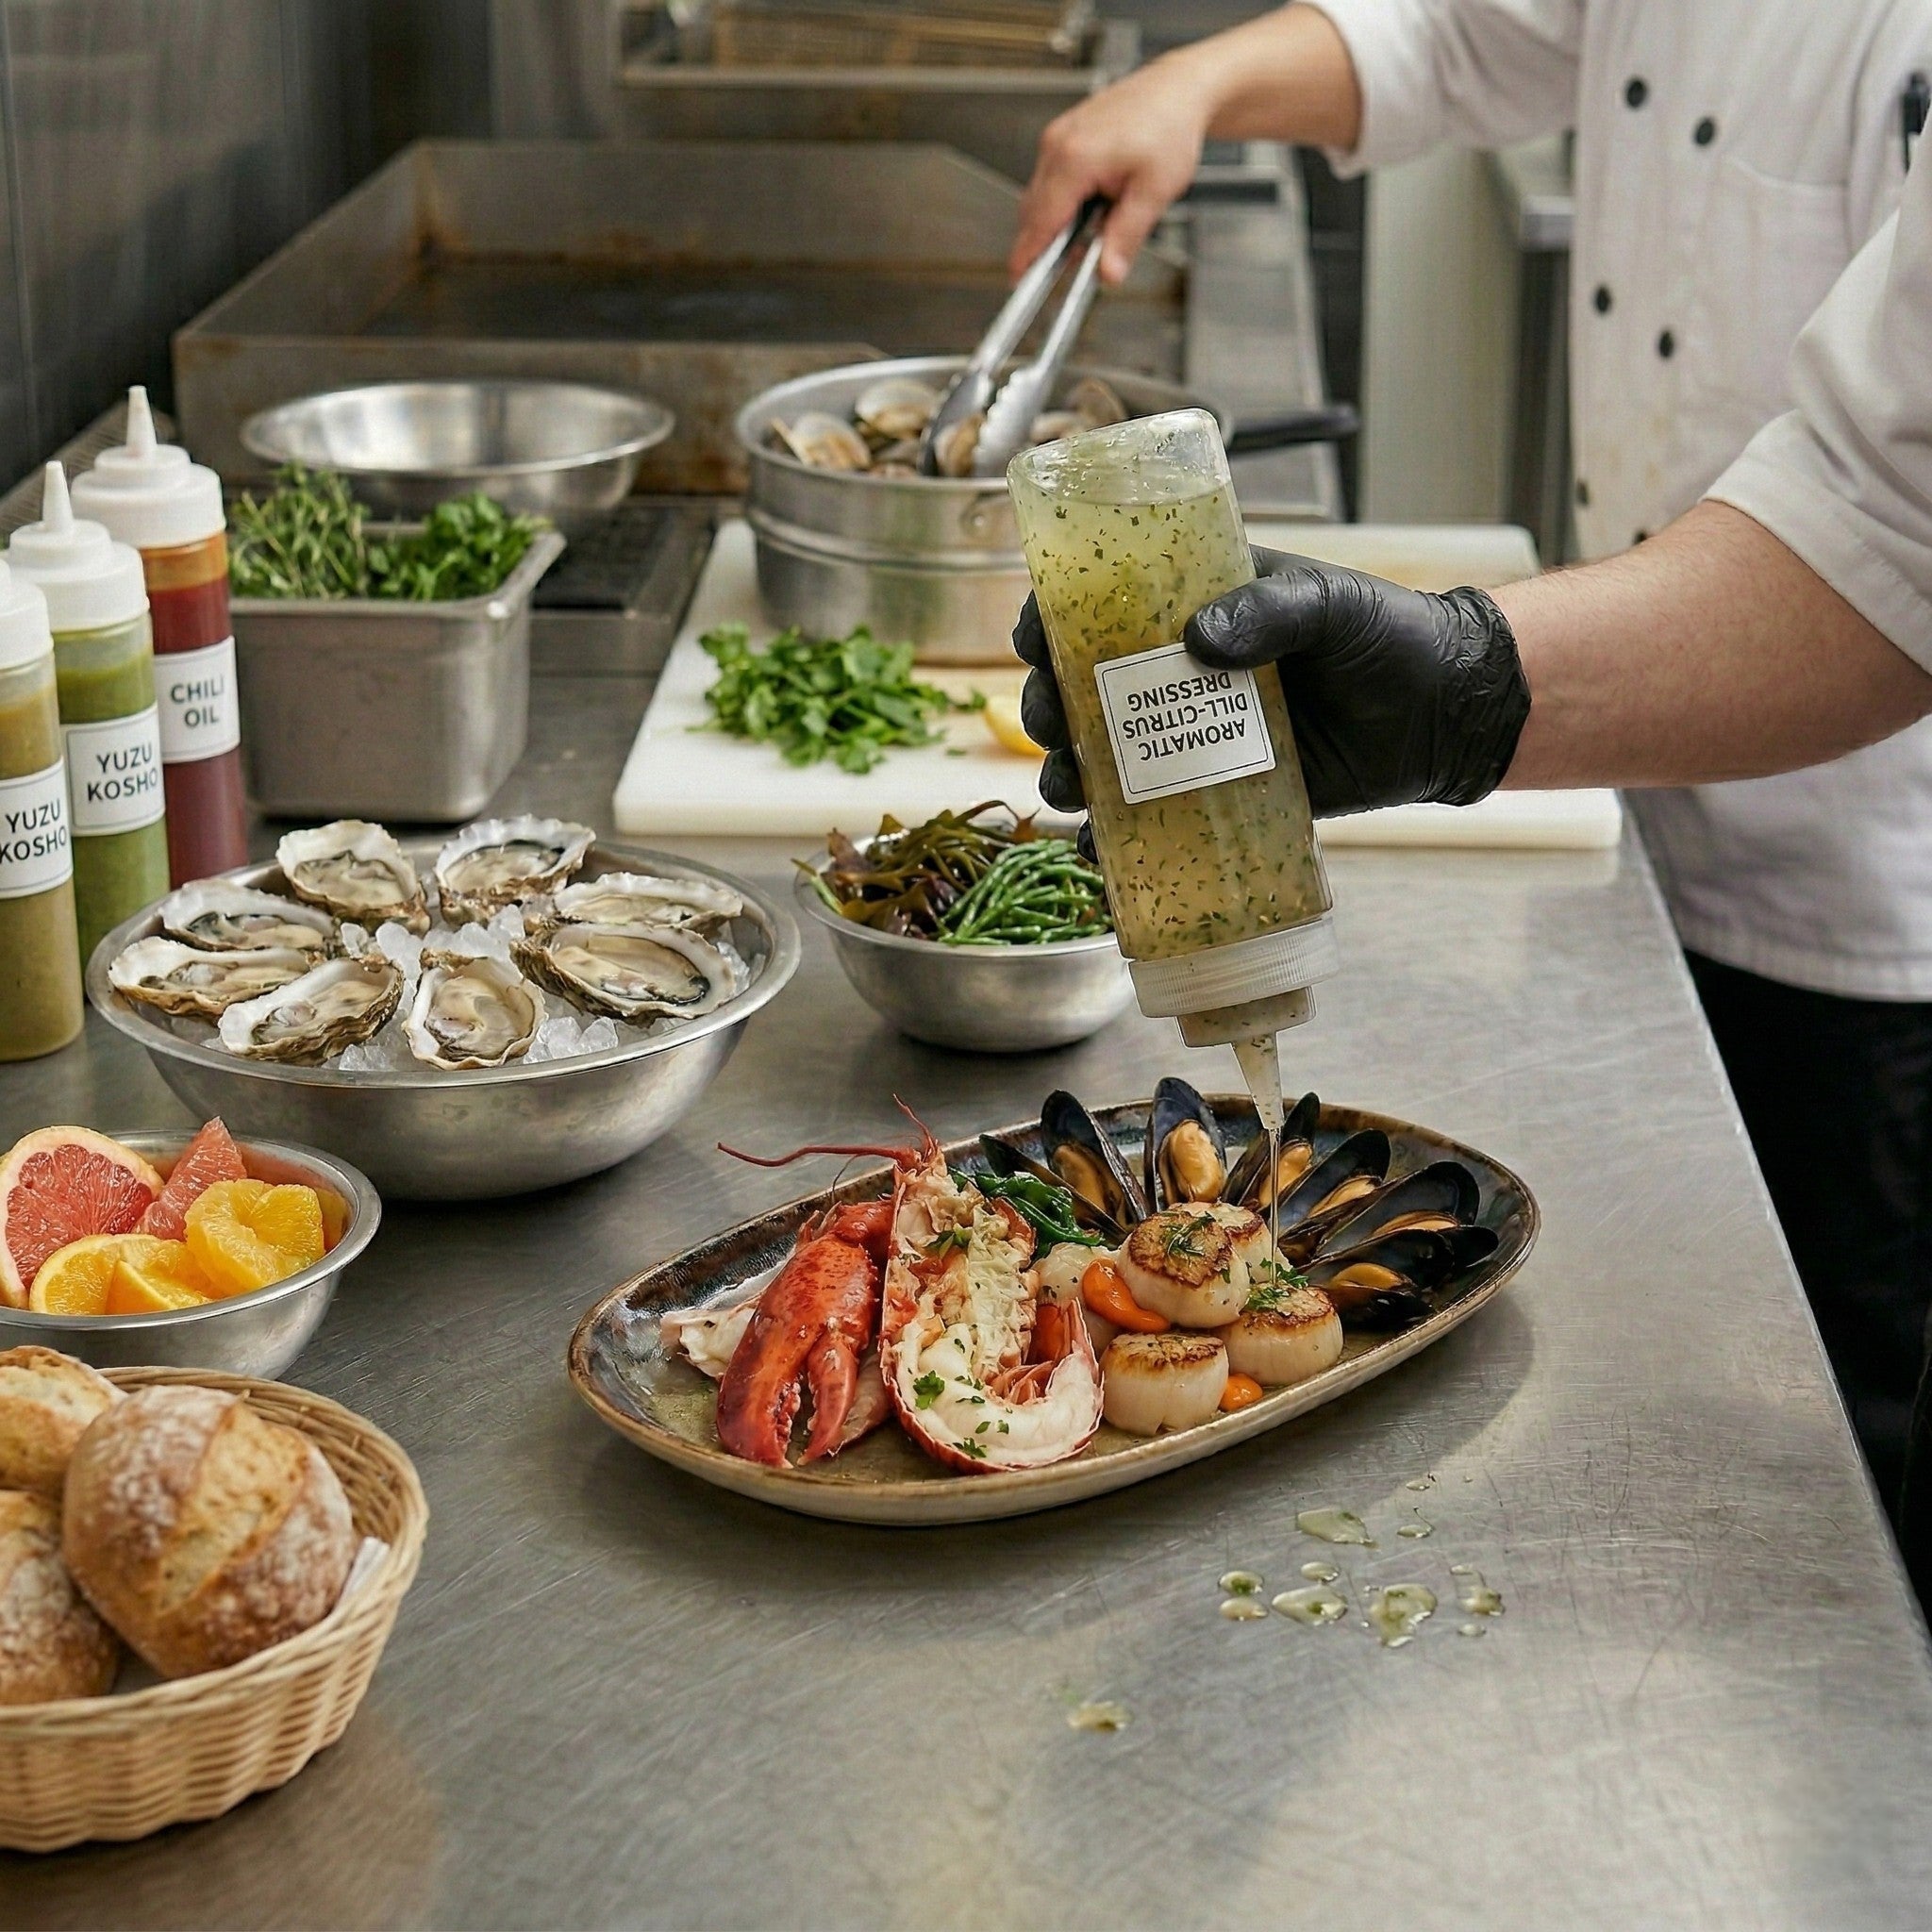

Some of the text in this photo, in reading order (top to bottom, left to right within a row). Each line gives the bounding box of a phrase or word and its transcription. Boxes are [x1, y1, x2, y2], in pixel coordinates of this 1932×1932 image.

[1127, 672, 1232, 711] DRESSING
[184, 706, 219, 727] OIL
[1123, 693, 1248, 739] DILL-CITRUS
[96, 741, 152, 774] YUZU
[1138, 718, 1245, 761] AROMATIC
[87, 767, 158, 802] KOSHO
[6, 798, 60, 833] YUZU
[0, 825, 67, 864] KOSHO
